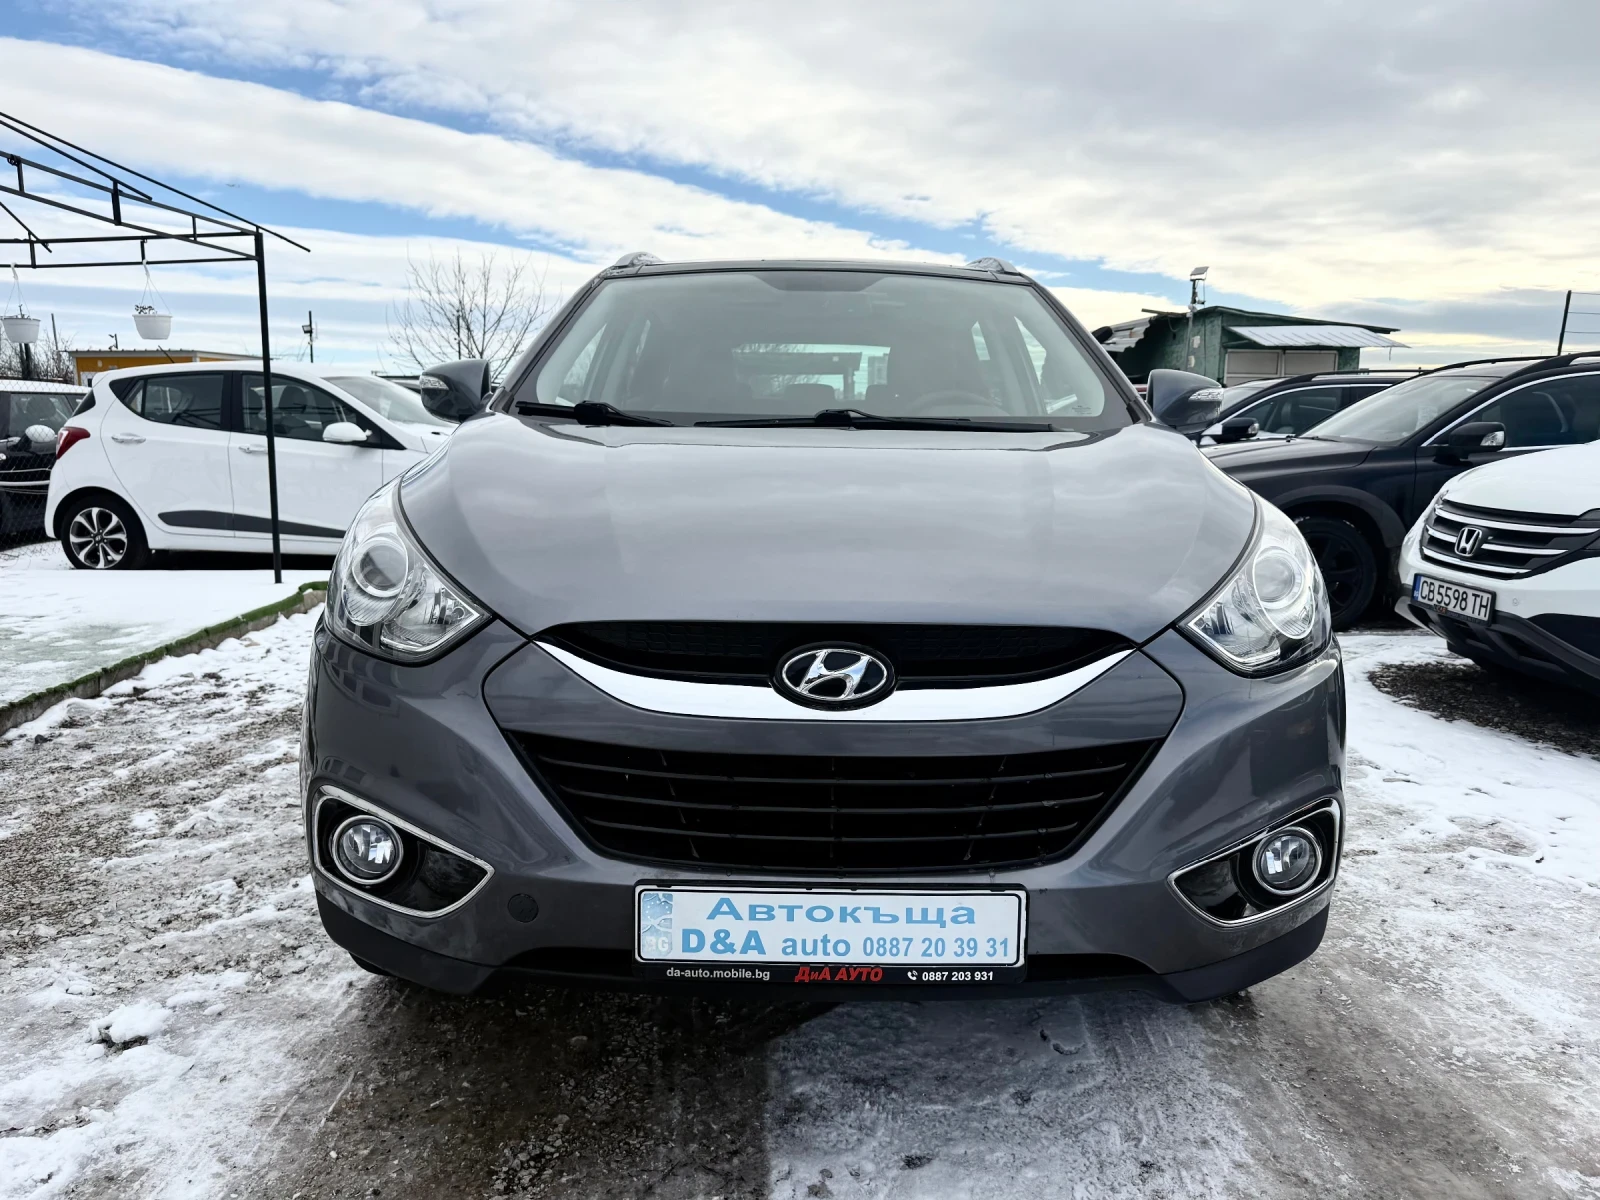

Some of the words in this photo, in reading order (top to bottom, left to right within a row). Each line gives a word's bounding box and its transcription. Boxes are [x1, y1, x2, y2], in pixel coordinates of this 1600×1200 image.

[1420, 580, 1435, 602] CB
[1436, 584, 1468, 611] 5598
[1472, 592, 1490, 618] TH
[706, 897, 976, 928] Автокъща
[681, 928, 767, 955] D&A
[781, 933, 851, 956] auto
[862, 937, 914, 957] 0887
[920, 937, 946, 957] 20
[953, 937, 978, 957] 39
[985, 937, 1008, 957] 31
[666, 967, 771, 981] da-auto.mobile.bg
[794, 966, 831, 983] ДиА
[834, 967, 883, 982] АУТО
[921, 971, 949, 981] 0887
[951, 971, 972, 981] 203
[974, 971, 994, 981] 931
